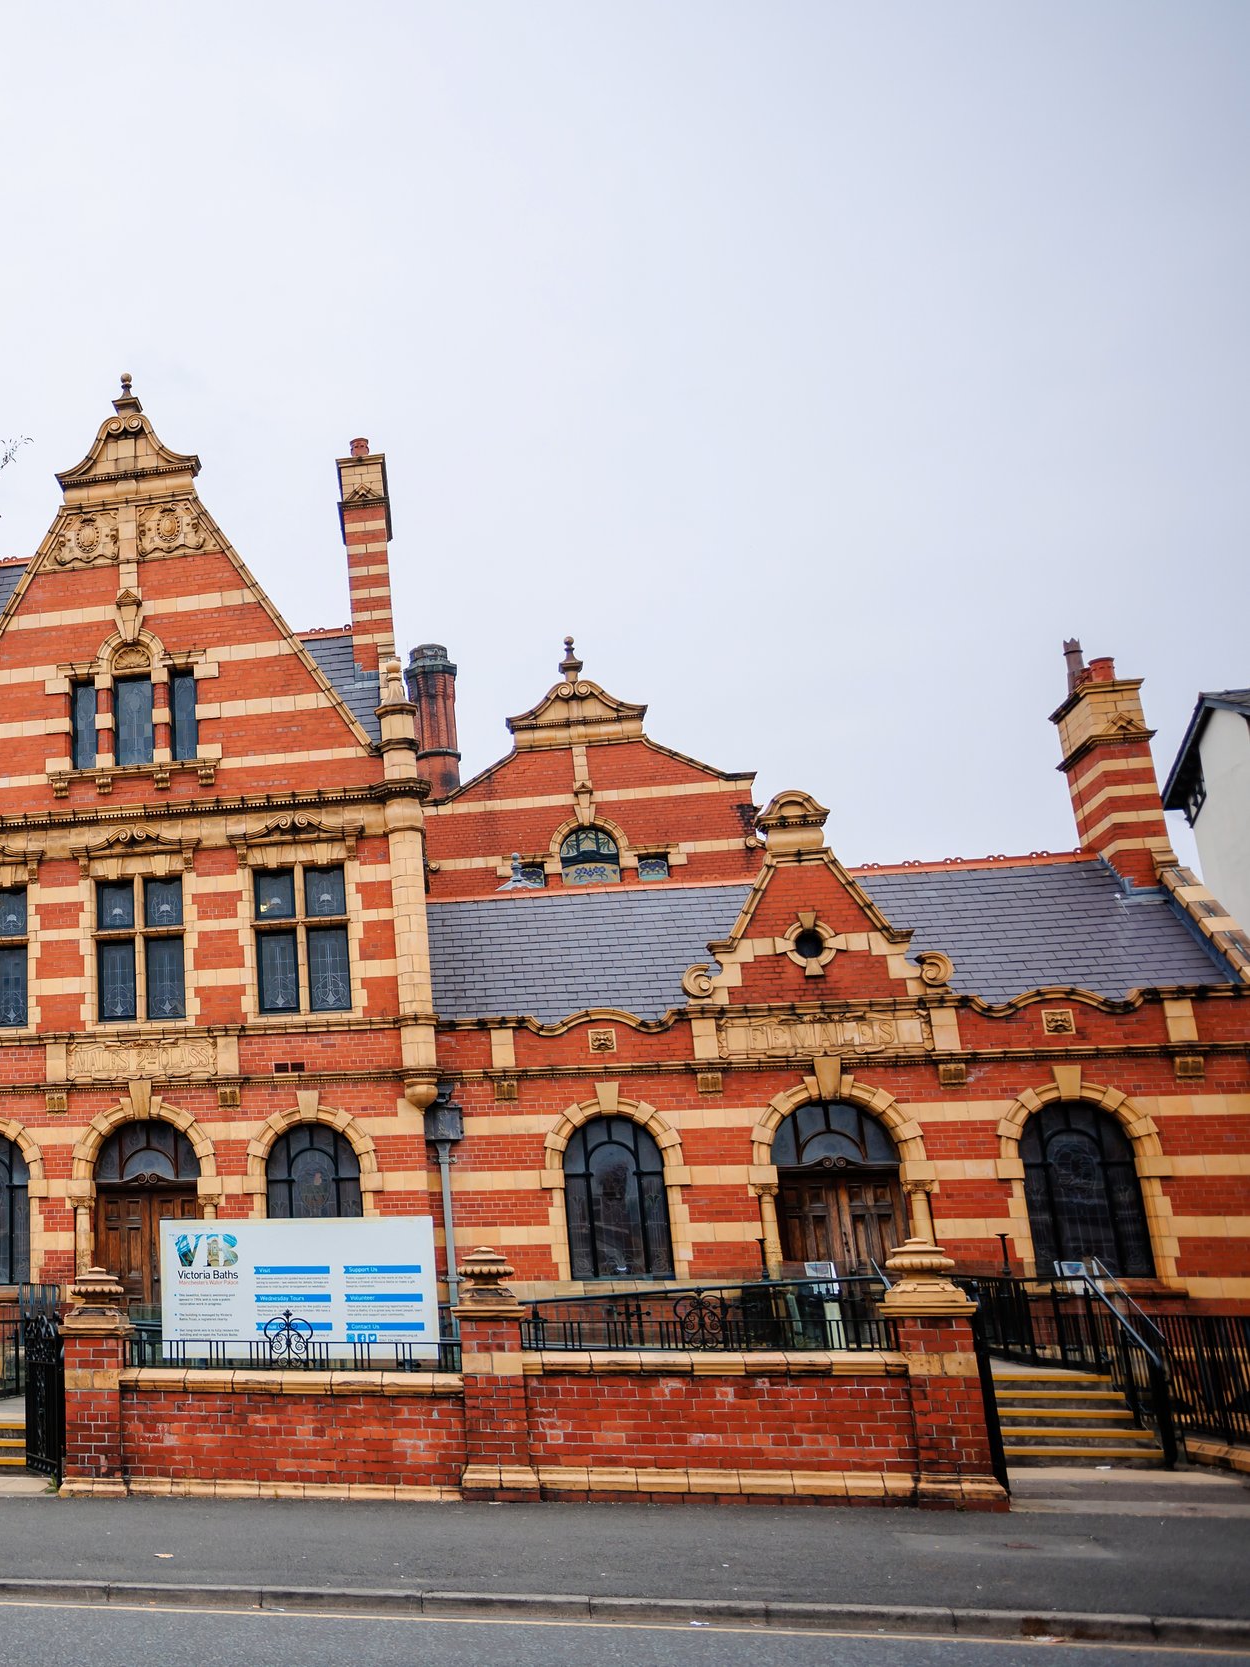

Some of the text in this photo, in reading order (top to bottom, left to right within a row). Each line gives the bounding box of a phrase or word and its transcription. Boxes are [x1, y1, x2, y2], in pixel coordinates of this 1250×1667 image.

[751, 1021, 896, 1049] FEMALES
[75, 1050, 130, 1072] MALES
[160, 1047, 209, 1069] CLASS
[178, 1270, 238, 1279] Victoria Baths
